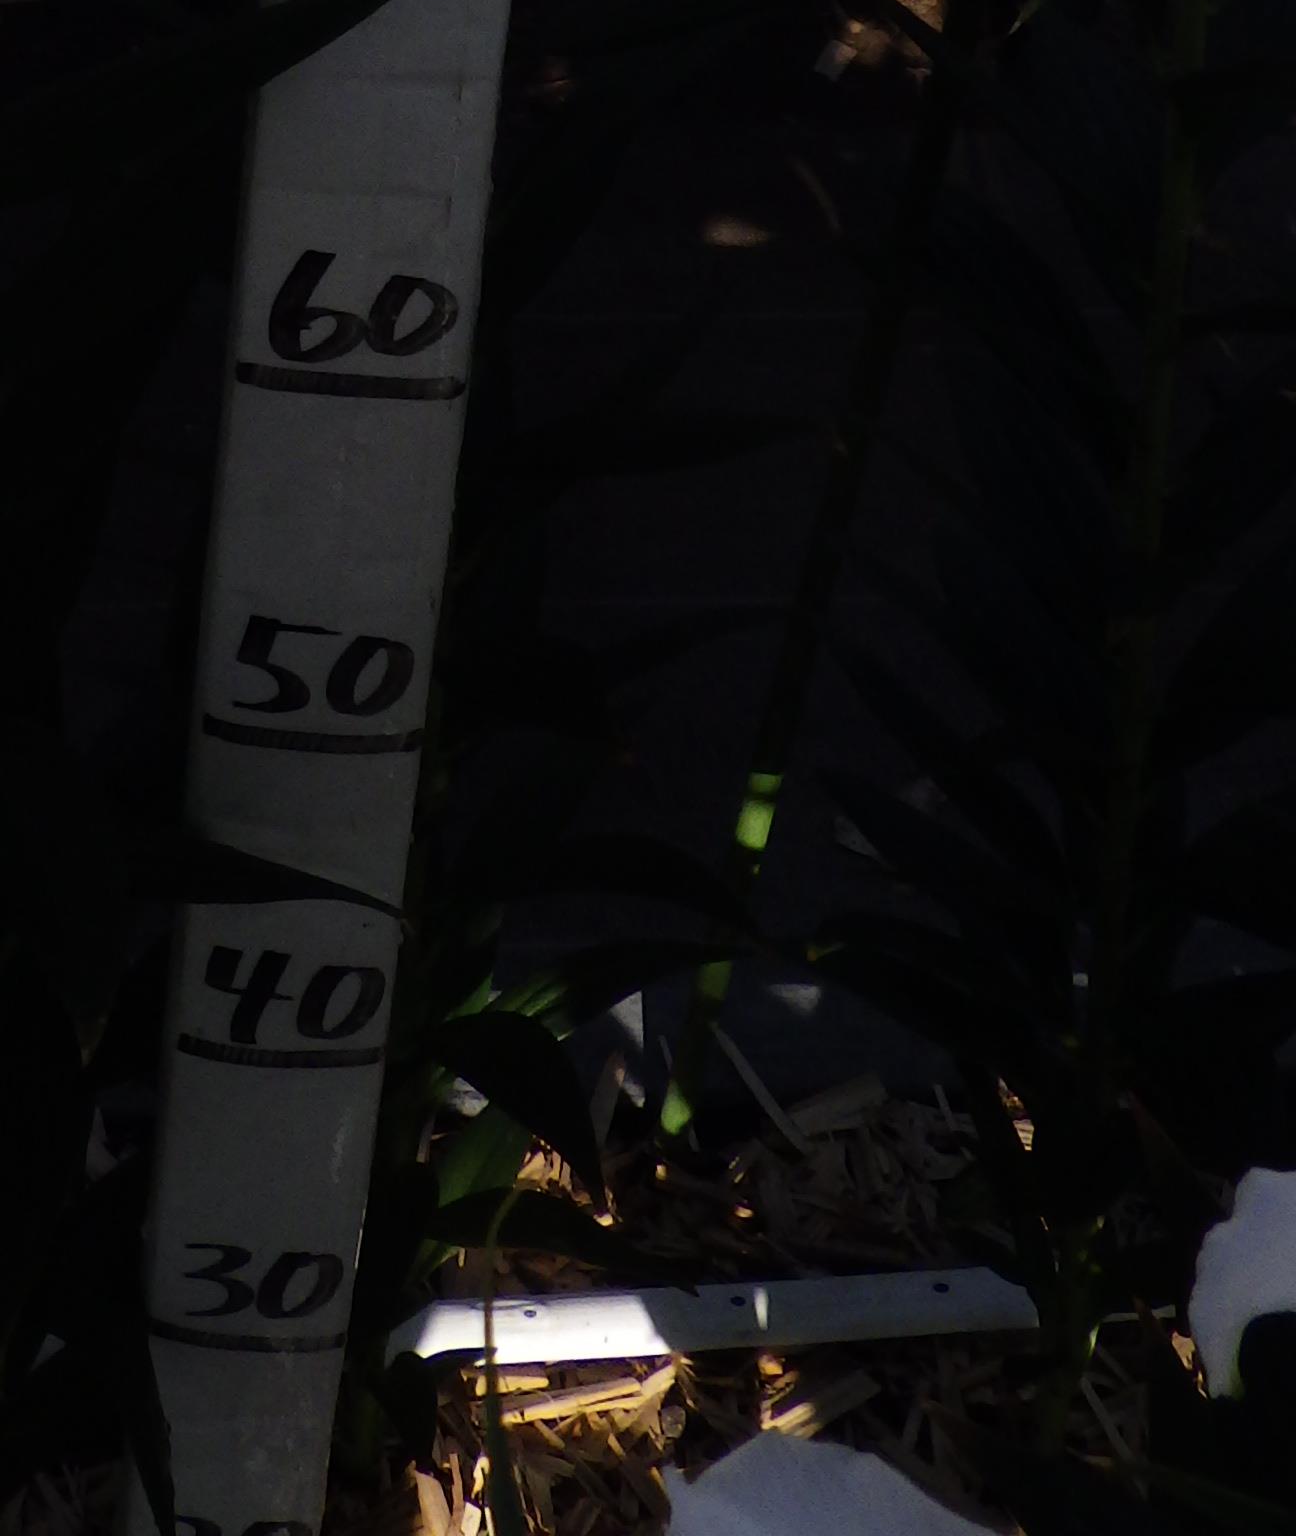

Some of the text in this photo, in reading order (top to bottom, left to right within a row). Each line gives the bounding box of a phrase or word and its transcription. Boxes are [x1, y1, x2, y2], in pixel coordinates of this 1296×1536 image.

[268, 249, 458, 363] 60
[232, 614, 415, 717] 50
[204, 945, 386, 1045] 40
[184, 1243, 345, 1319] 30
